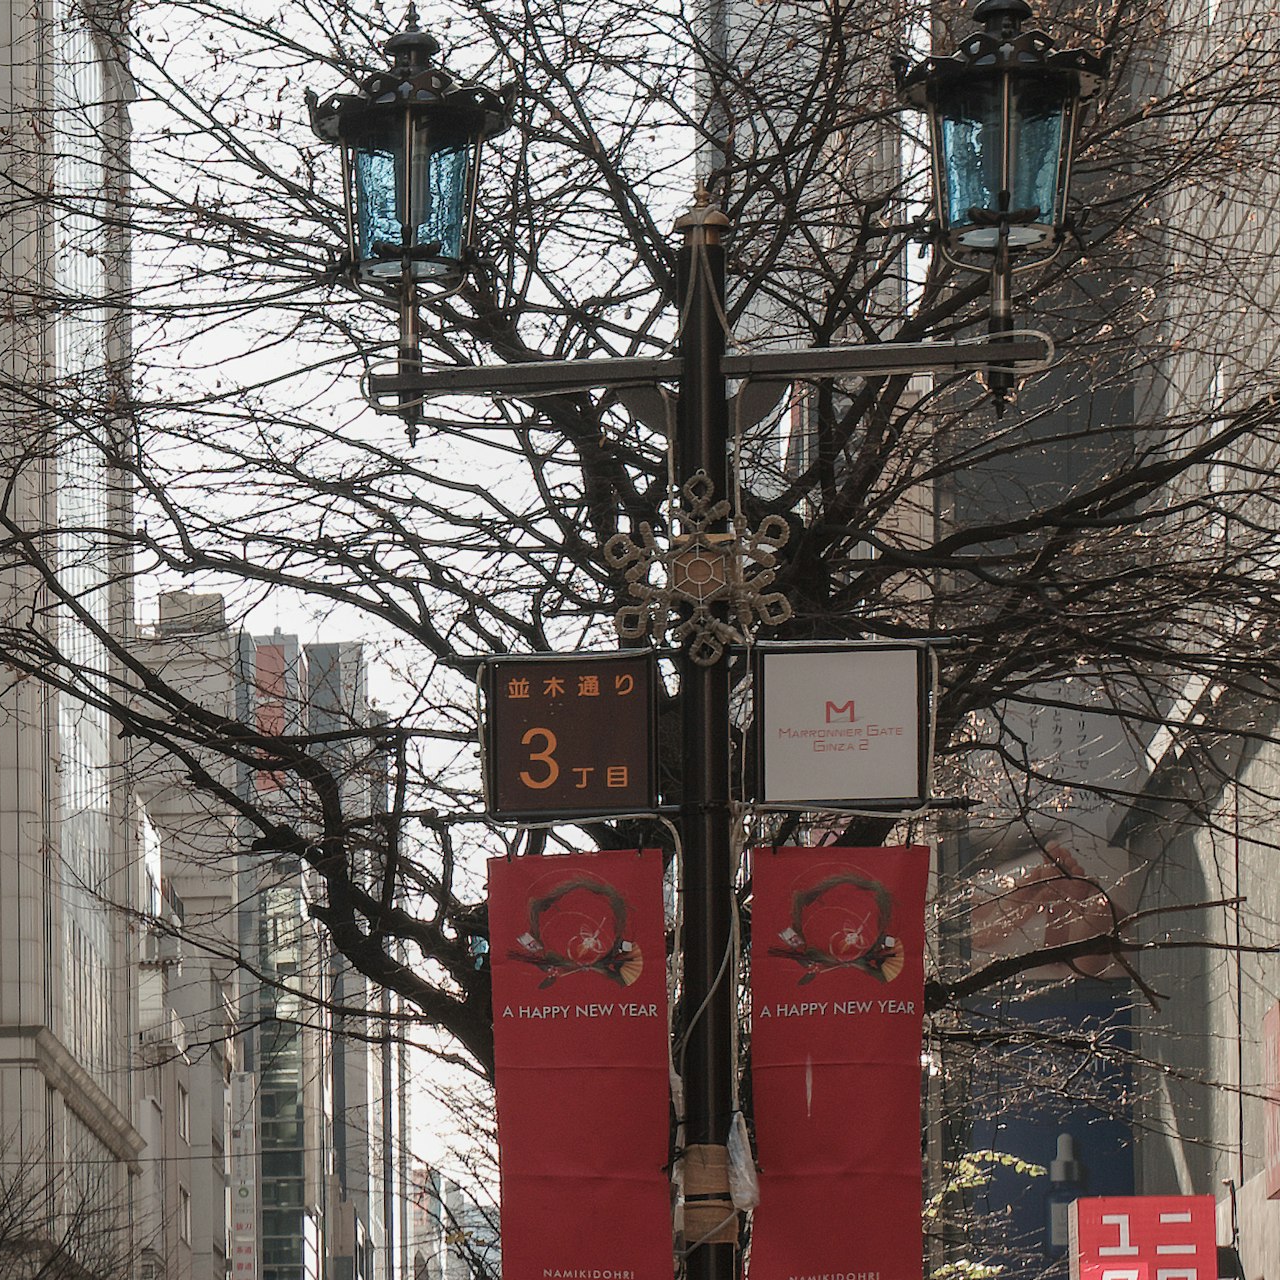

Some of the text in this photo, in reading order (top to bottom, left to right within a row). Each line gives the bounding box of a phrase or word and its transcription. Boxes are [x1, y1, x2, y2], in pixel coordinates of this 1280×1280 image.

[508, 674, 635, 699] 並木通り
[778, 724, 904, 739] MARRONNIER GATE
[813, 739, 869, 753] GINZA 2
[519, 727, 628, 790] 3丁目
[503, 1003, 658, 1018] A HAPPY NEW YEAR
[759, 1000, 916, 1018] A HAPPY NEW YEAR
[543, 1268, 635, 1280] NAMIKIDOHRI
